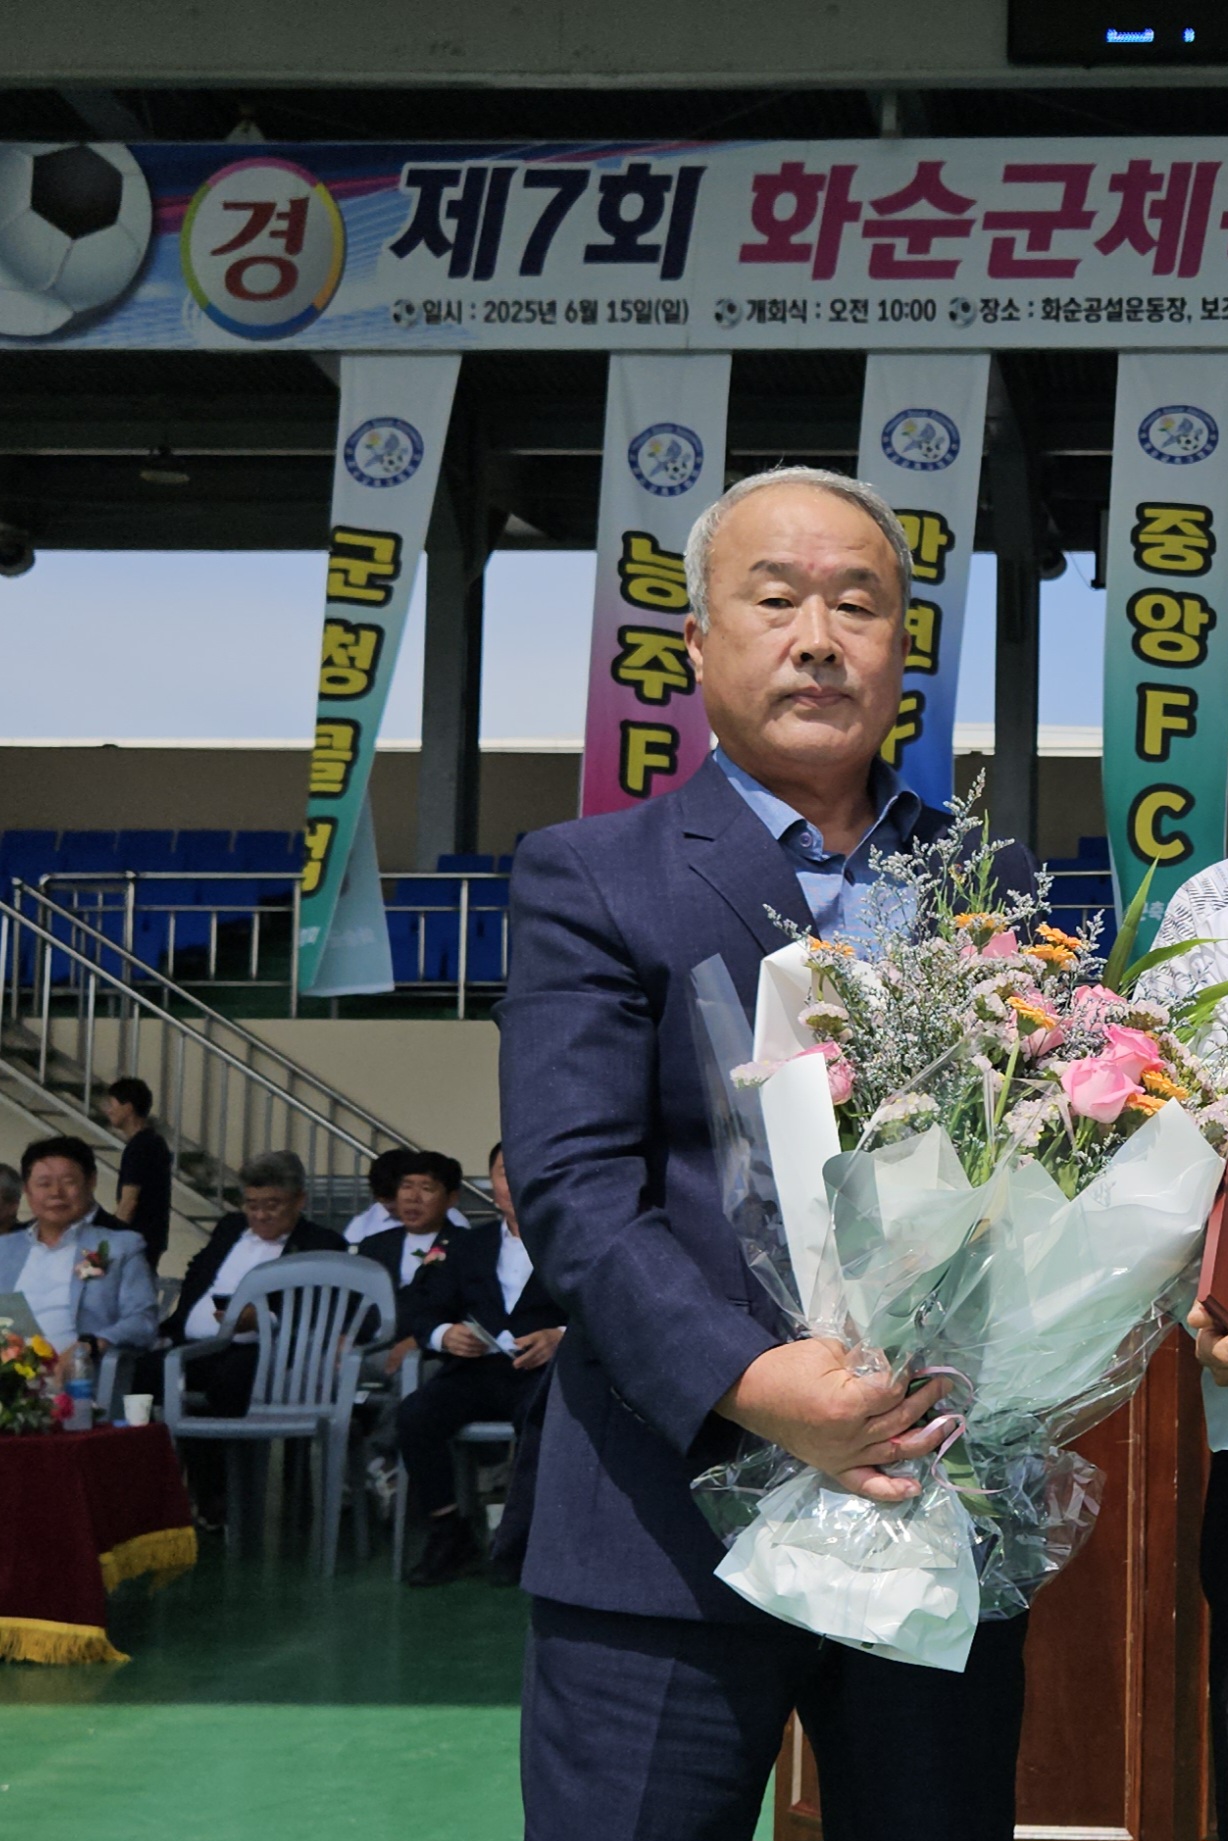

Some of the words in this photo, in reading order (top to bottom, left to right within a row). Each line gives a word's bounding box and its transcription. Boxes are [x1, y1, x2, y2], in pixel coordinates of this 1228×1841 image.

[210, 197, 311, 302] 경
[389, 161, 708, 282] 제7회
[422, 299, 463, 326] 일시
[483, 299, 557, 326] 2025년
[565, 298, 598, 326] 6월
[607, 298, 689, 326] 15일(일)
[747, 298, 808, 325] 개회식
[829, 298, 869, 324] 오전
[878, 299, 936, 323] 10:00
[979, 297, 1021, 324] 장소
[1130, 504, 1214, 864] 중앙FC
